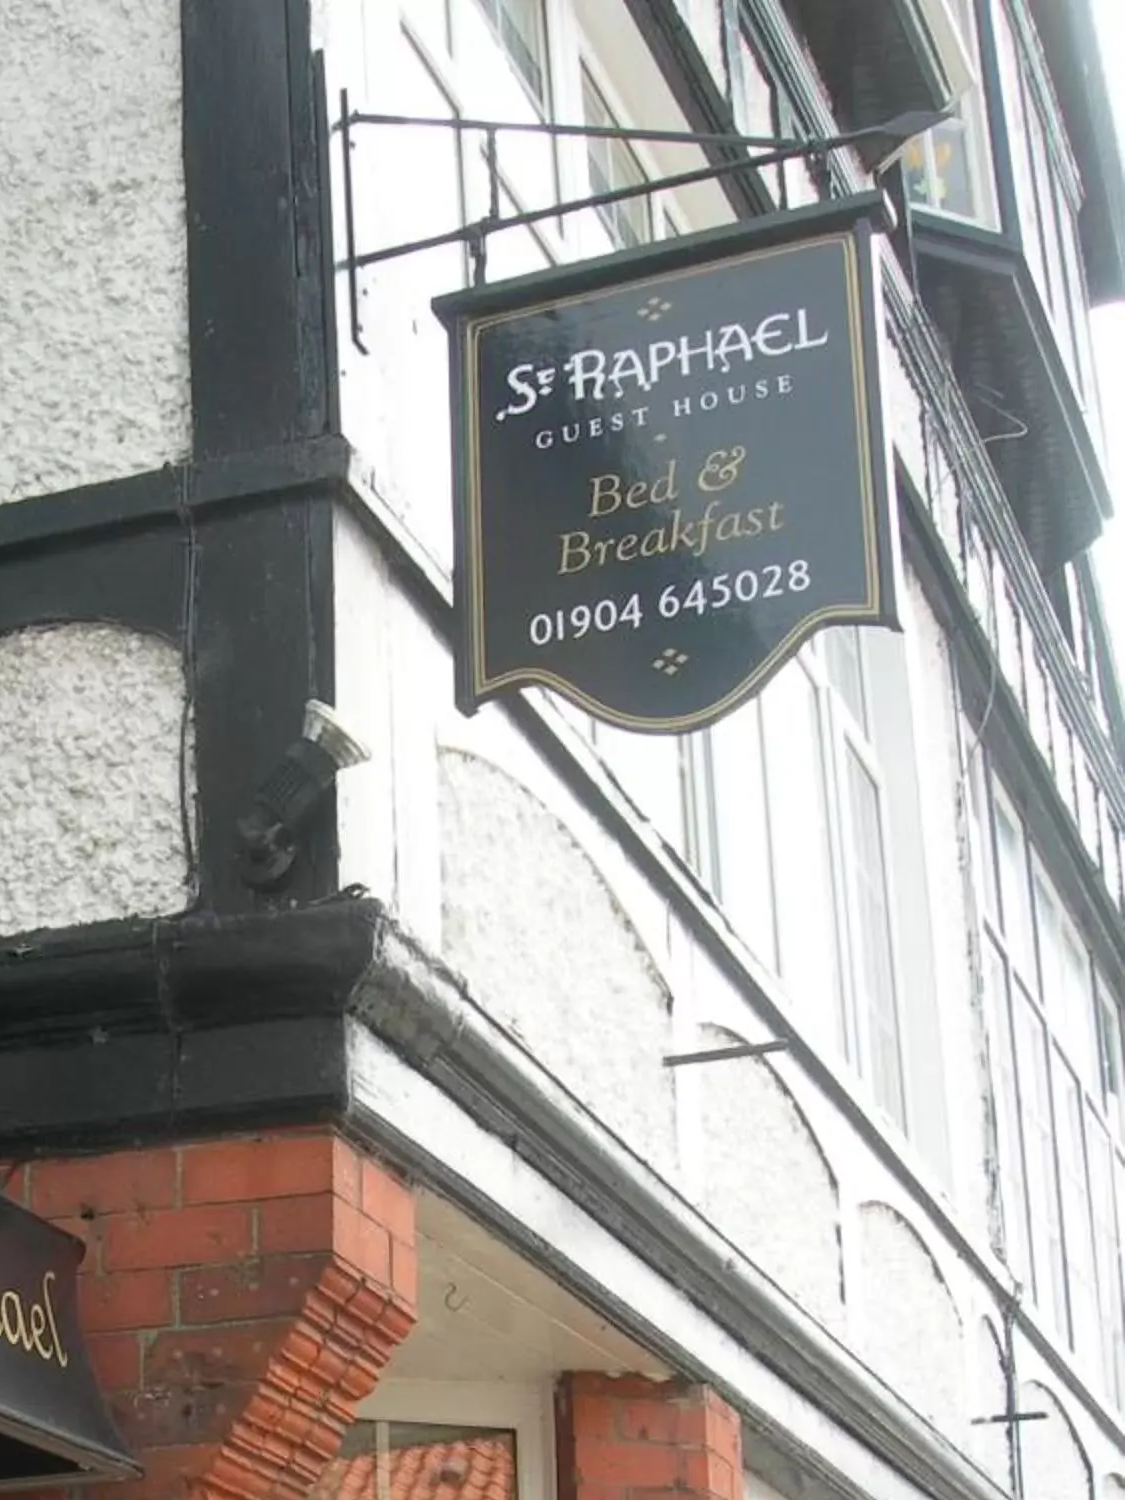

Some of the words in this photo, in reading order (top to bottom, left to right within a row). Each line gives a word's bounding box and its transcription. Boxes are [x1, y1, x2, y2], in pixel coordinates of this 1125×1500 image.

[563, 308, 830, 400] RAPHAEL
[535, 406, 650, 449] GUEST
[673, 375, 795, 417] HOUSE
[588, 460, 679, 518] Bed
[698, 446, 747, 492] &
[557, 500, 784, 575] Breakfast
[529, 599, 643, 646] 01904
[658, 560, 812, 618] 645028
